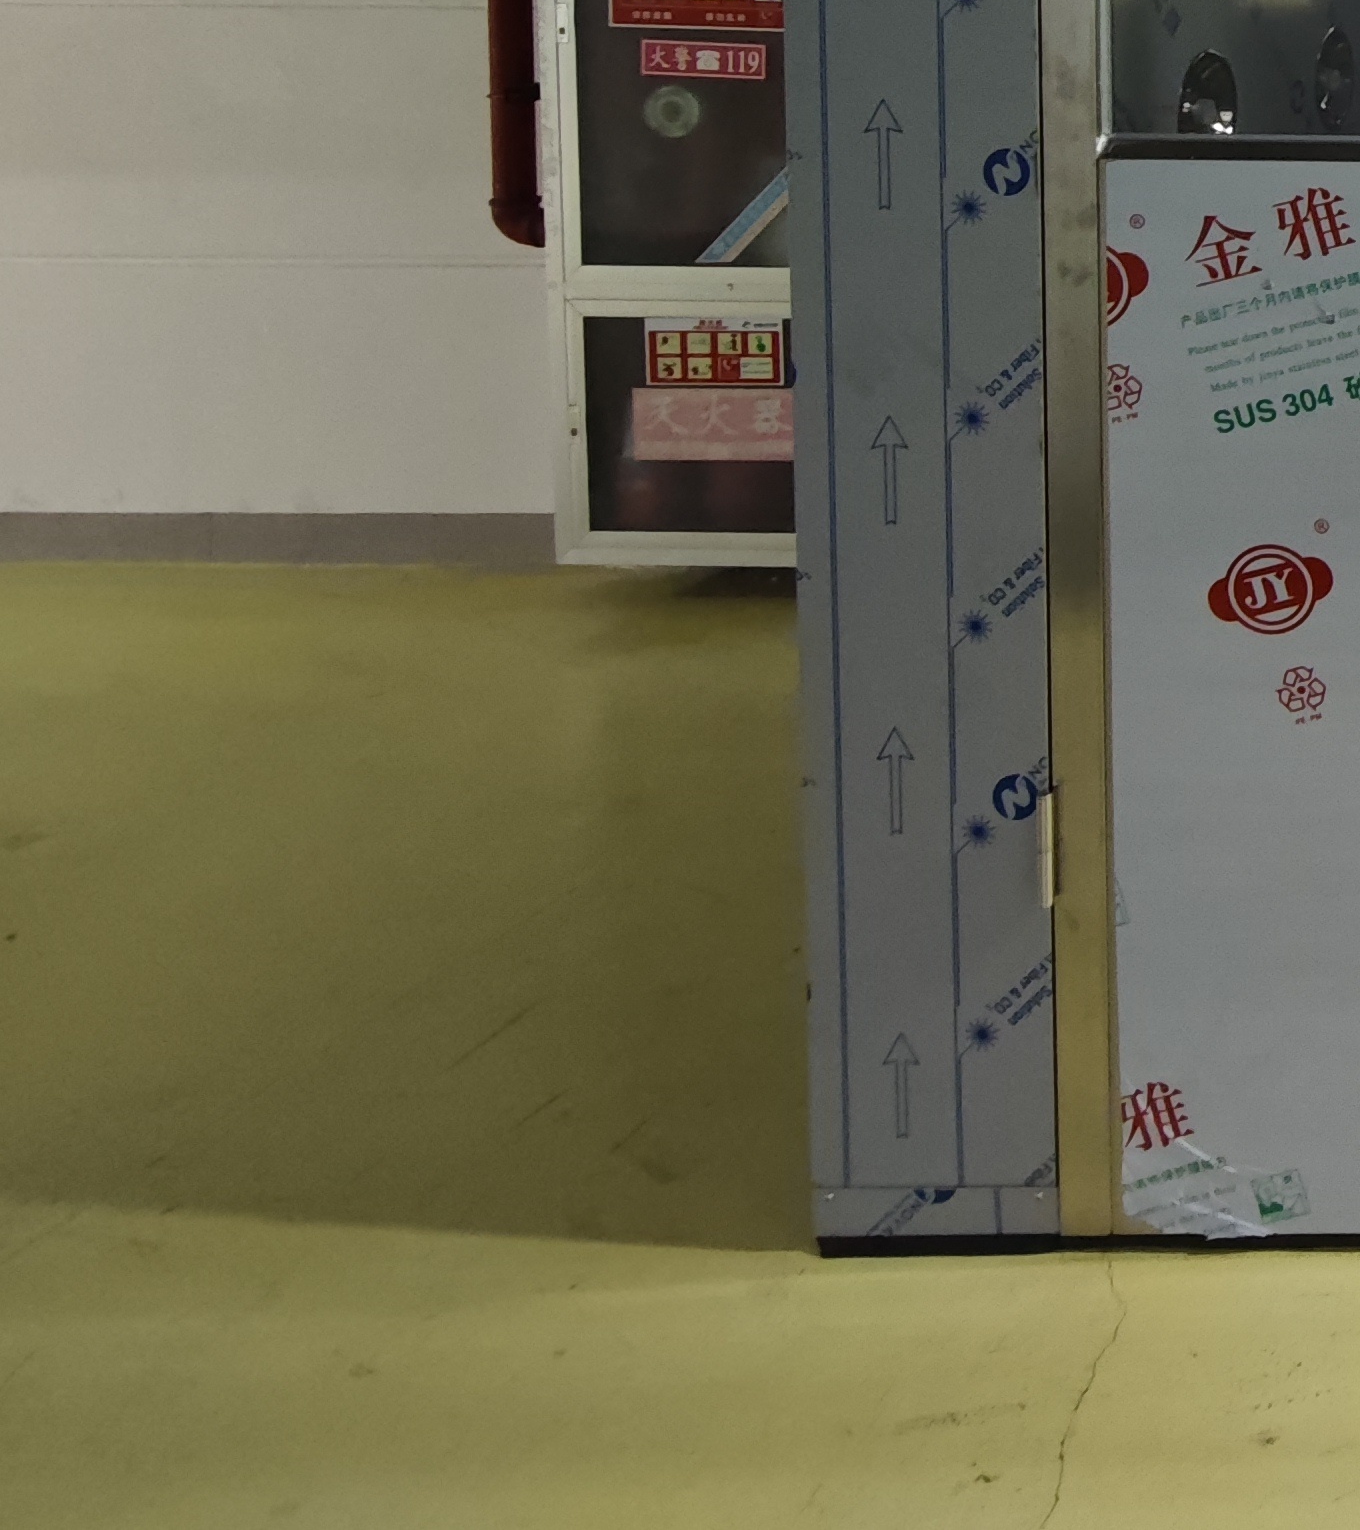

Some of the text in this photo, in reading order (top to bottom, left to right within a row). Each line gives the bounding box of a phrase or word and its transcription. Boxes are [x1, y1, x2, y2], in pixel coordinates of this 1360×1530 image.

[726, 50, 760, 74] 119
[1183, 186, 1356, 288] 金雅
[1213, 398, 1277, 433] SUS
[1281, 383, 1334, 416] 304
[1242, 566, 1296, 610] JY
